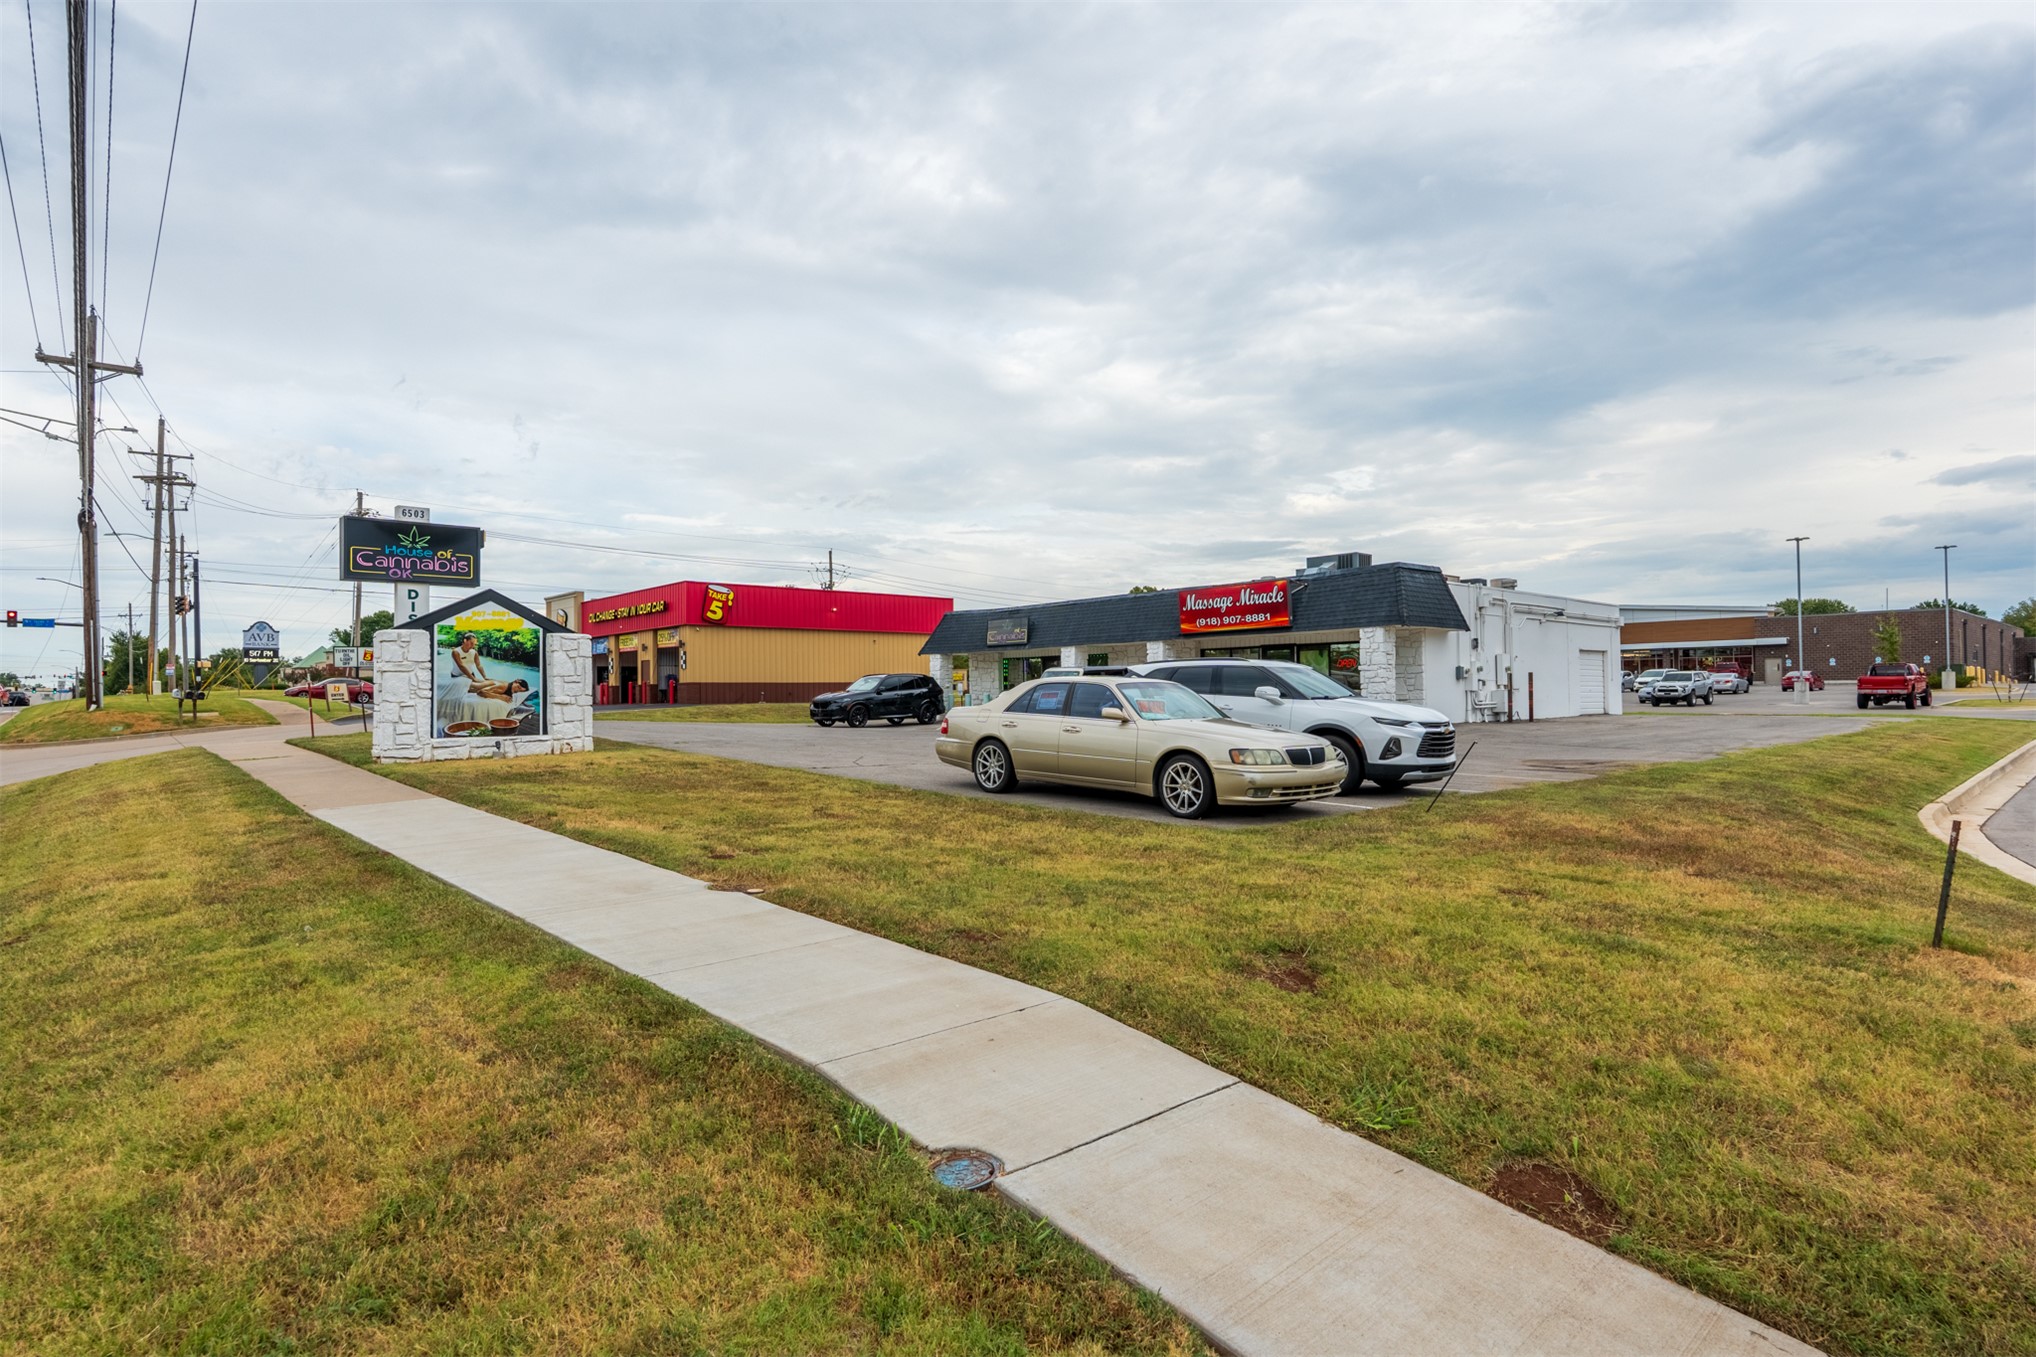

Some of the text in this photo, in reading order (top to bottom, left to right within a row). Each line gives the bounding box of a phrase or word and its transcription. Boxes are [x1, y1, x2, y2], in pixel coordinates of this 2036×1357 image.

[401, 508, 425, 519] 6503
[385, 545, 454, 559] House of
[356, 551, 469, 573] Cannabis
[388, 568, 413, 579] OK
[708, 589, 727, 601] TAKE
[1182, 585, 1285, 613] Massage Miracle
[596, 609, 615, 622] CHANGE
[617, 606, 630, 618] STAY
[630, 605, 636, 616] IN
[637, 602, 651, 615] YOUR
[651, 600, 665, 612] CAR
[706, 600, 723, 620] 5
[1196, 612, 1271, 628] (918) 907-8881
[249, 632, 275, 642] AVB
[1337, 658, 1357, 668] OPEN
